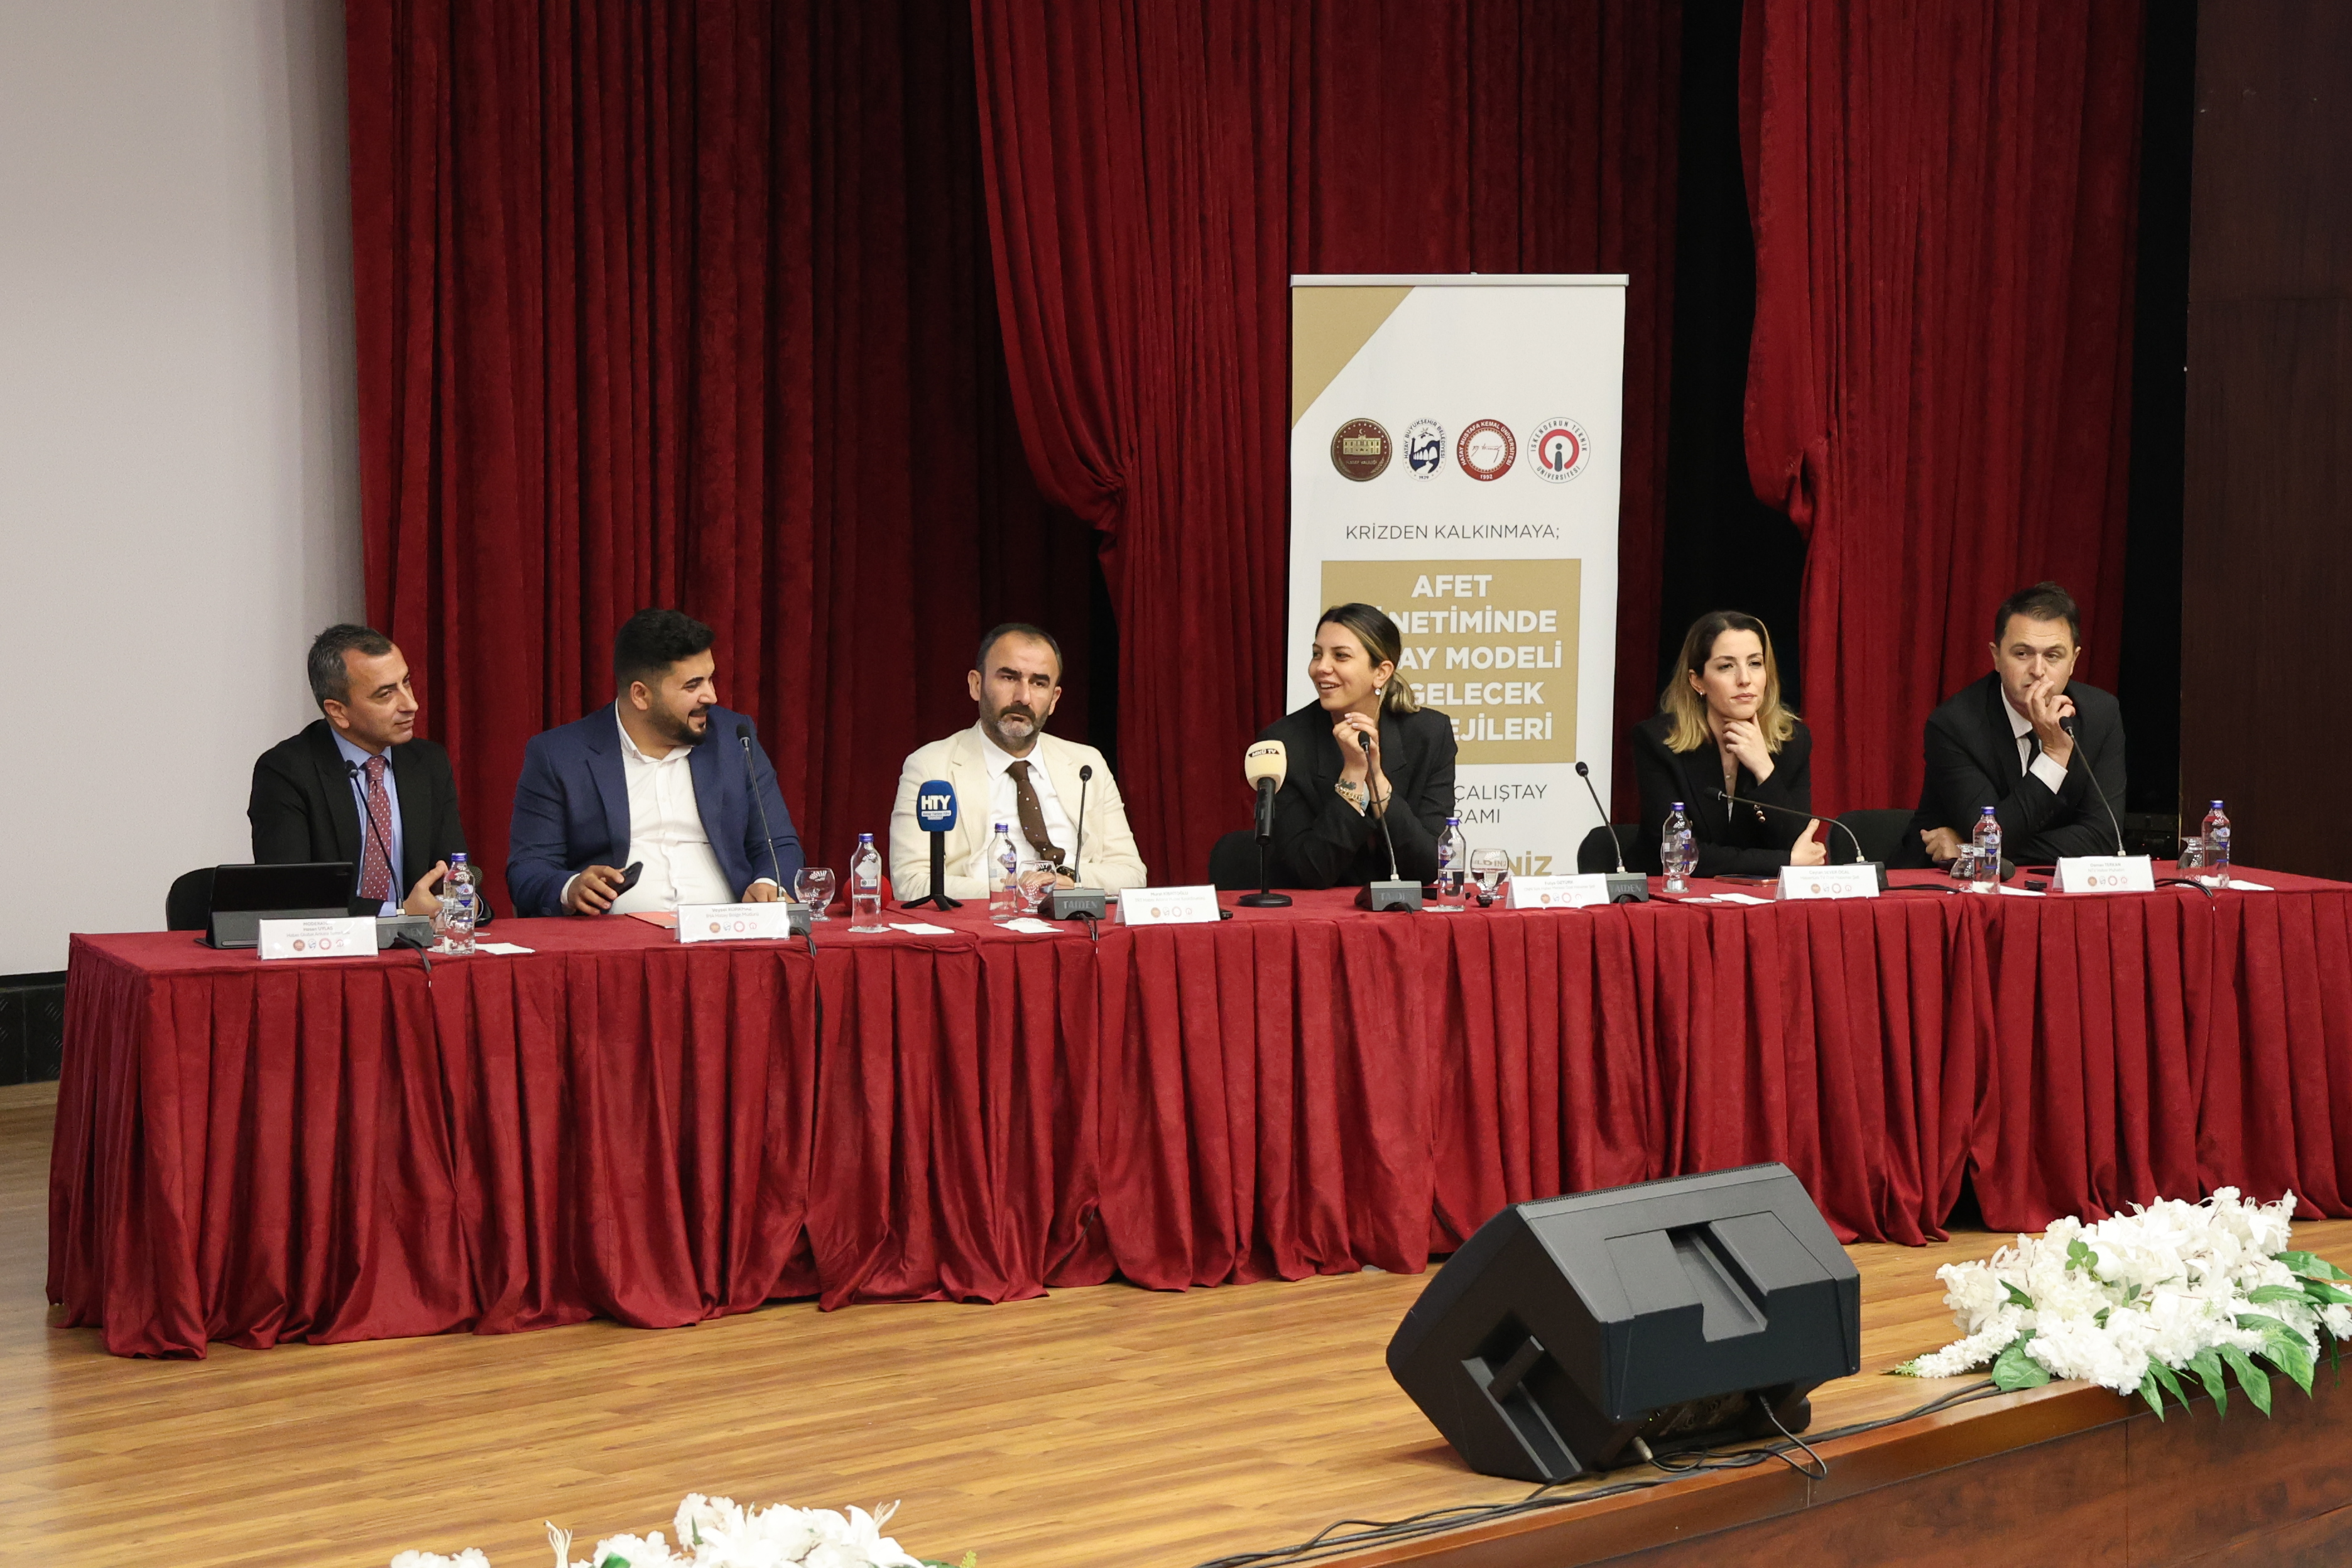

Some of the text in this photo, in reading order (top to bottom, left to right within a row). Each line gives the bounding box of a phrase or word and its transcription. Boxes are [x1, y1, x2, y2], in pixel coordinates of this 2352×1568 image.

[1460, 423, 1481, 446] MUSTAFA
[1481, 421, 1500, 429] KEMAL
[1459, 447, 1467, 466] HATAY
[1346, 523, 1559, 540] KRİZDEN KALKINMAYA;
[1410, 574, 1493, 598] AFET
[1377, 605, 1557, 634] NETİMİNDE
[1398, 640, 1562, 670] AY MODELİ
[1410, 682, 1545, 706] GELECEK
[1452, 712, 1553, 741] EJİLERİ
[921, 795, 951, 810] HTY
[1454, 784, 1547, 803] ÇALIŞTAY
[1454, 808, 1500, 824] RAMI
